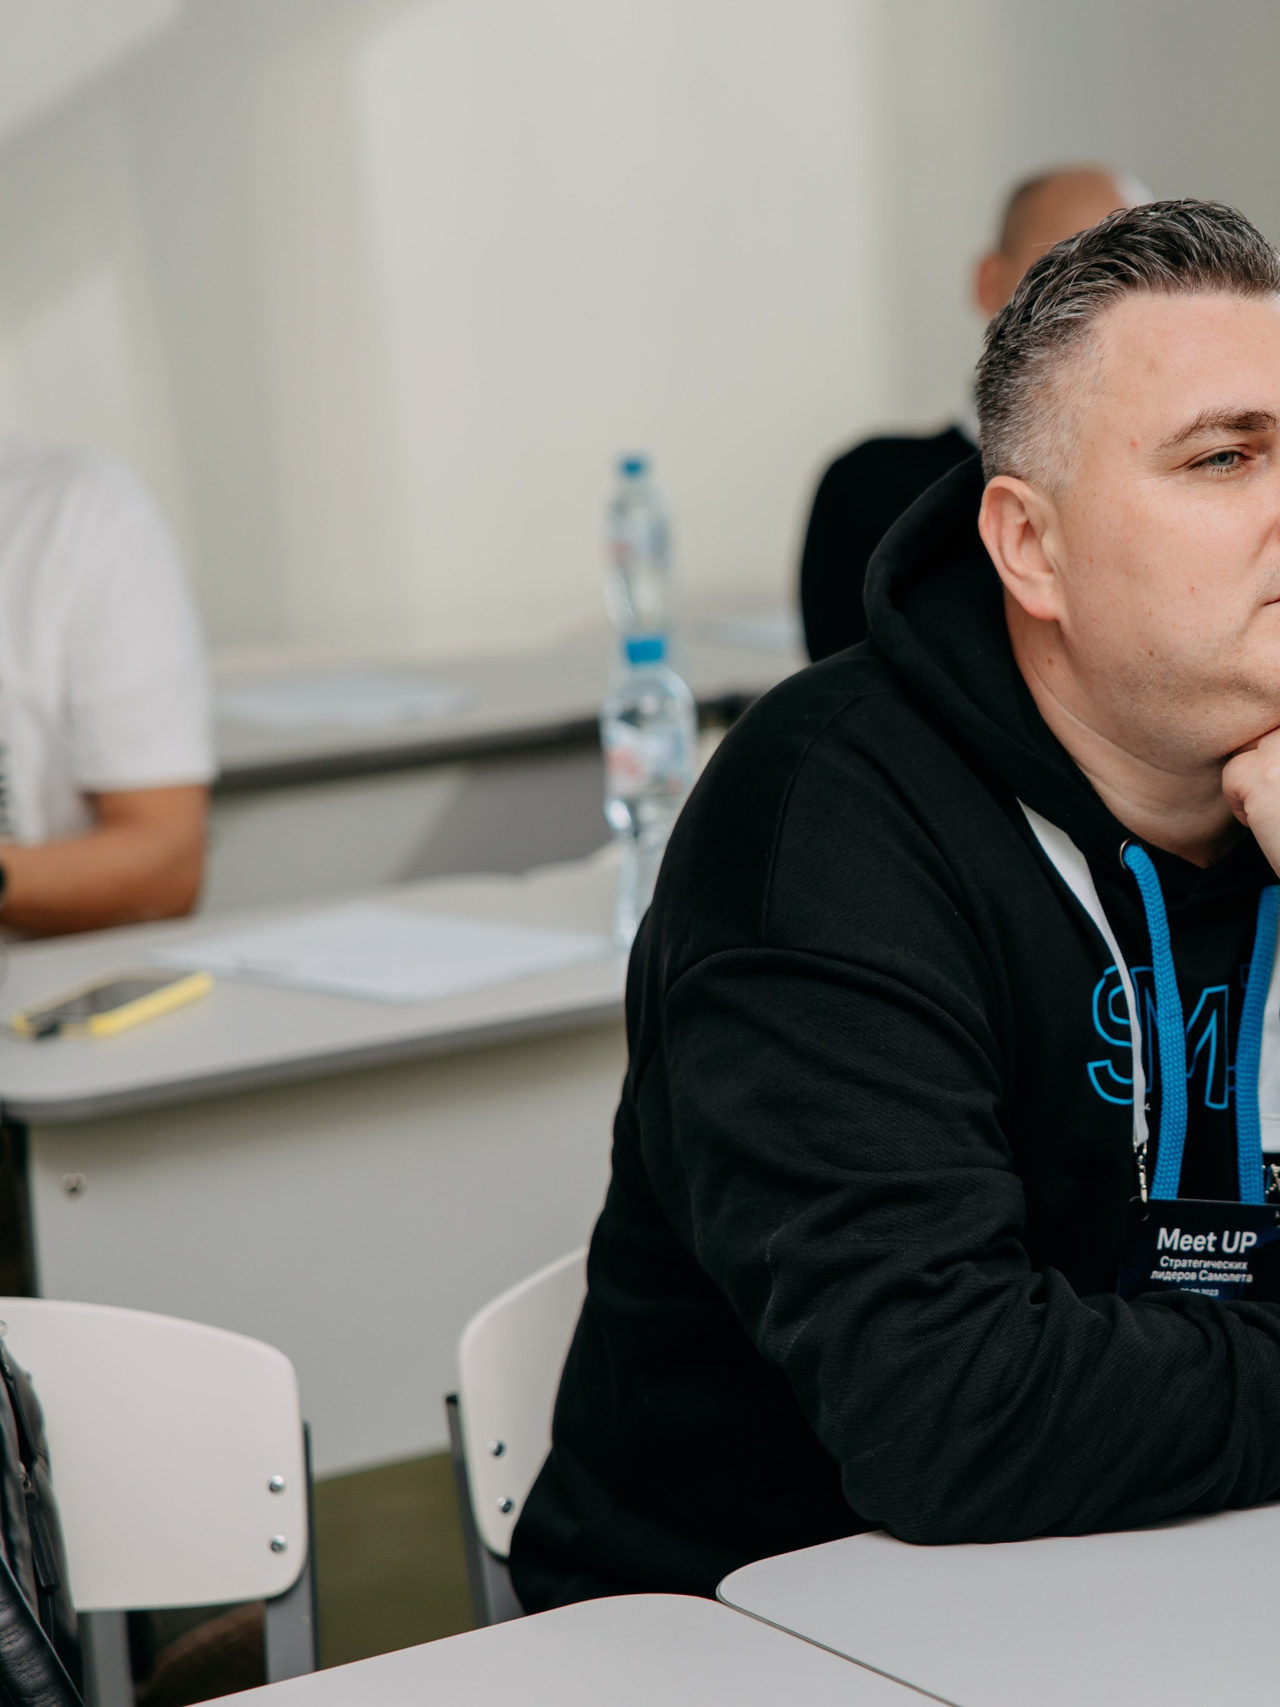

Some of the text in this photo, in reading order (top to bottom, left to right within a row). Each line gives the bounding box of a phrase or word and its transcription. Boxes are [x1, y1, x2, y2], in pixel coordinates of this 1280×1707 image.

[1157, 1227, 1257, 1253] Meet UP
[1160, 1255, 1248, 1271] Стратегических
[1150, 1269, 1253, 1283] лидеров Самолета
